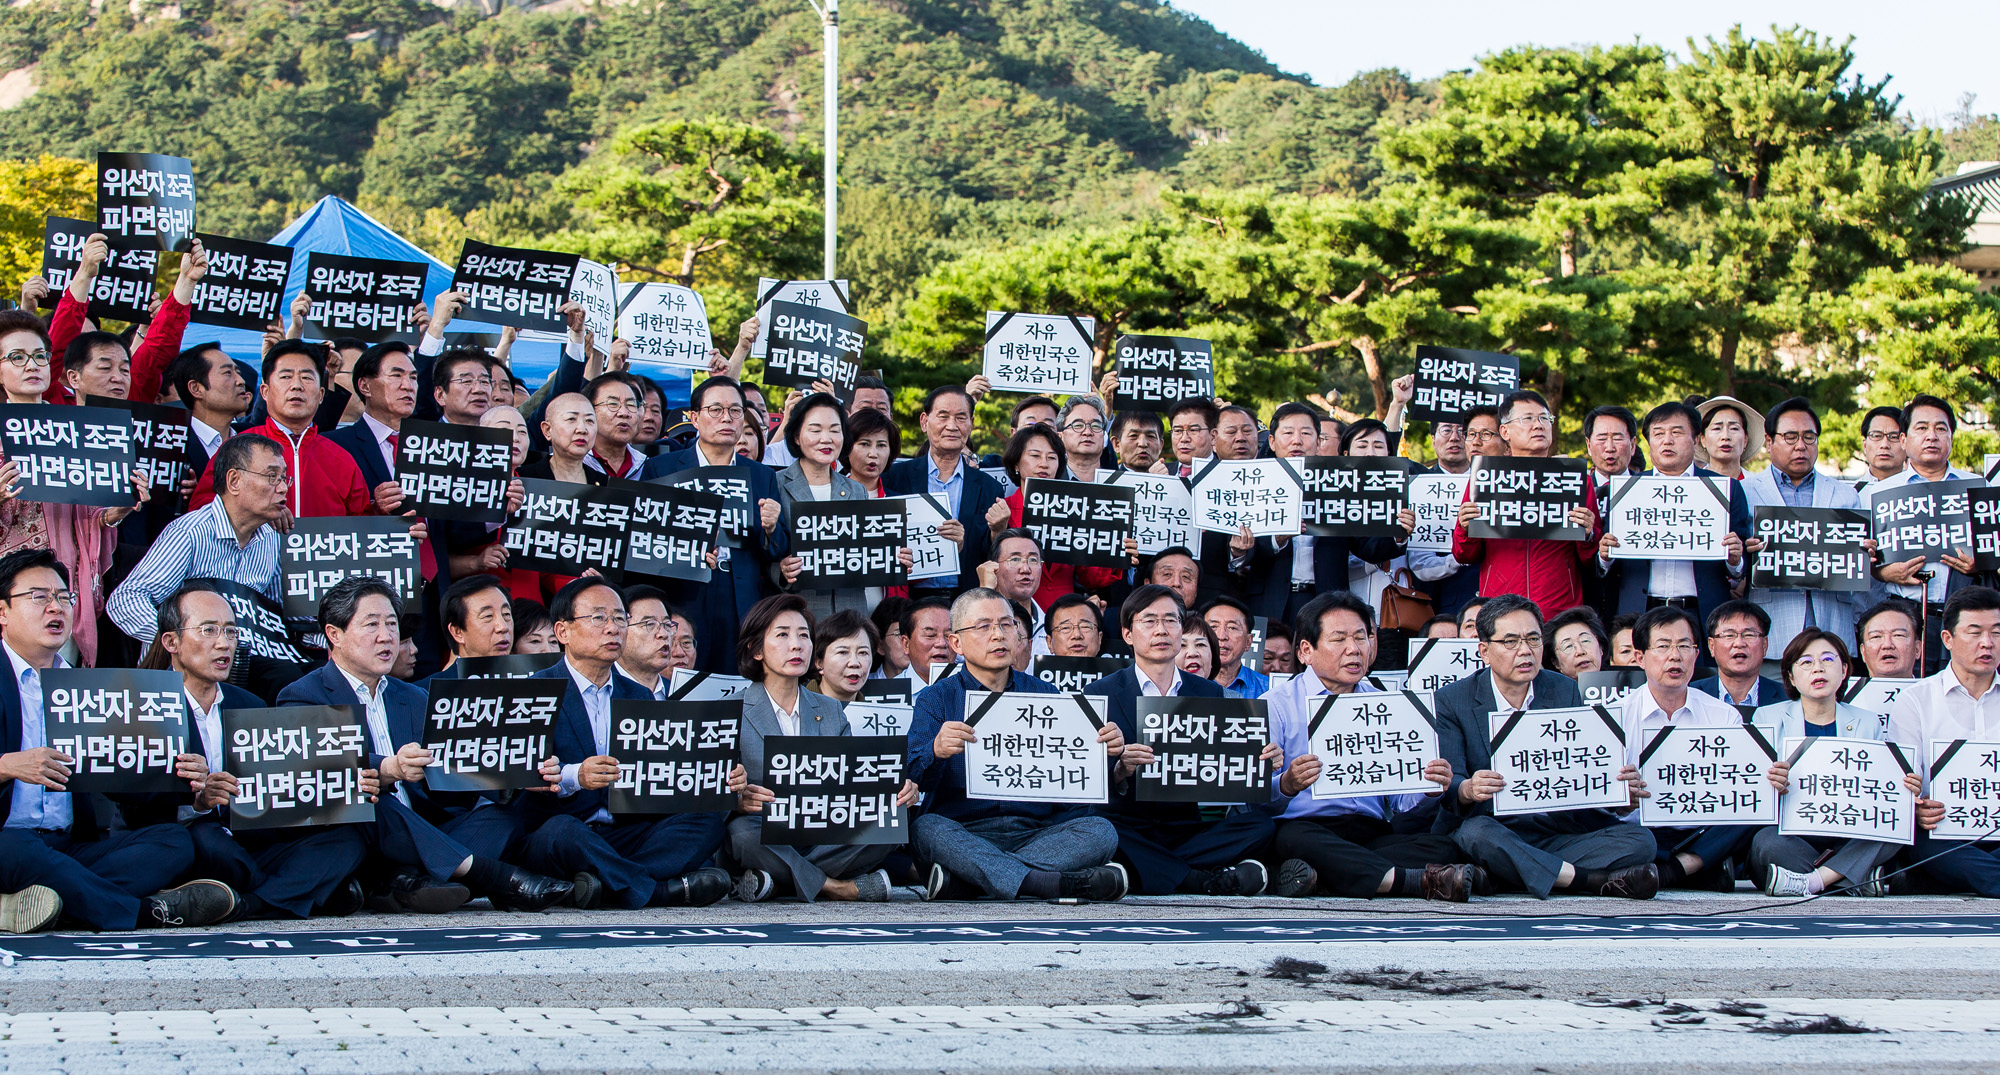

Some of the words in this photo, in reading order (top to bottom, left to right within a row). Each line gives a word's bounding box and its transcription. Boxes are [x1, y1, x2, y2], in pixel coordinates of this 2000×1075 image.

[103, 168, 165, 197] 위선자
[166, 173, 192, 200] 조국
[102, 205, 194, 239] 파면하라!
[118, 250, 157, 274] 조국
[248, 258, 287, 286] 조국
[463, 254, 525, 281] 위선자
[526, 262, 571, 288] 조국
[48, 268, 151, 311] 파하라!
[311, 266, 375, 296] 위선자
[376, 276, 421, 300] 조국
[580, 269, 604, 292] 자유
[456, 281, 562, 321] 파면하라!
[658, 292, 687, 312] 자유
[794, 289, 822, 307] 자유
[306, 301, 415, 333] 파면하라!
[633, 312, 706, 338] 대한민국은
[1024, 322, 1057, 341] 자유
[632, 335, 708, 360] 죽었습니다
[774, 314, 833, 347] 위선자
[835, 328, 864, 358] 조국
[1000, 342, 1080, 364] 대한민국은
[1119, 346, 1176, 371] 위선자
[1179, 350, 1210, 373] 조국
[770, 348, 858, 391] 파면하라!
[996, 364, 1079, 386] 죽었습니다
[1418, 357, 1477, 384] 위선자
[1478, 364, 1517, 390] 조국
[5, 418, 79, 449] 위선자
[84, 423, 130, 453] 조국
[154, 423, 188, 454] 조국
[403, 435, 470, 468] 위선자
[471, 443, 511, 472] 조국
[11, 454, 131, 493] 파면하라!
[1231, 467, 1265, 486] 자유
[1303, 469, 1360, 493] 위선자
[1363, 470, 1405, 492] 조국
[1475, 469, 1537, 494] 위선자
[1540, 471, 1583, 496] 조국
[400, 472, 507, 509] 파면하라!
[708, 478, 749, 502] 조국
[1135, 481, 1168, 501] 자유
[1206, 487, 1289, 506] 대한민국은
[1427, 482, 1460, 500] 자유
[1652, 485, 1688, 503] 자유
[514, 492, 580, 525] 위선자
[582, 501, 630, 532] 조국
[633, 497, 671, 527] 선자
[672, 505, 717, 534] 조국
[1028, 491, 1089, 521] 위선자
[1091, 499, 1132, 524] 조국
[1206, 508, 1288, 528] 죽었습니다
[1626, 507, 1715, 527] 대한민국은
[1875, 494, 1937, 524] 위선자
[796, 514, 860, 541] 위선자
[863, 513, 903, 539] 조국
[1624, 531, 1714, 550] 죽었습니다
[1758, 518, 1820, 545] 위선자
[1824, 522, 1867, 545] 조국
[286, 532, 360, 561] 위선자
[365, 532, 415, 559] 조국
[504, 526, 622, 568] 파면하라!
[630, 531, 708, 569] 면하라!
[796, 546, 901, 577] 파면하라!
[1757, 550, 1863, 579] 파면하라!
[257, 605, 288, 639] 조국
[236, 626, 309, 663] 면하라!
[50, 688, 133, 724] 위선자
[138, 691, 183, 725] 조국
[431, 697, 503, 729] 위선자
[505, 696, 557, 725] 조국
[1014, 704, 1059, 730] 자유
[1352, 703, 1393, 727] 자유
[617, 718, 694, 751] 위선자
[698, 718, 738, 749] 조국
[862, 713, 901, 736] 자유
[1142, 713, 1217, 746] 위선자
[1223, 716, 1268, 747] 조국
[1540, 719, 1581, 743] 자유
[233, 726, 310, 763] 위선자
[316, 724, 365, 757] 조국
[426, 734, 546, 774] 파면하라!
[982, 733, 1090, 761] 대한민국은
[1325, 729, 1424, 757] 대한민국은
[1688, 735, 1730, 759] 자유
[769, 753, 848, 786] 위선자
[852, 754, 902, 784] 조국
[1142, 752, 1265, 788] 파면하라!
[1326, 757, 1426, 786] 죽었습니다
[1510, 744, 1611, 773] 대한민국은
[1830, 748, 1873, 772] 자유
[1979, 750, 2000, 773] 자
[235, 768, 366, 810] 파면하라!
[982, 763, 1090, 791] 죽었습니다
[1510, 773, 1611, 801] 죽었습니다
[1657, 763, 1762, 786] 대한민국은
[1799, 774, 1900, 802] 대한민국은
[767, 793, 899, 829] 파면하라!
[1655, 790, 1762, 814] 죽었습니다
[1796, 802, 1899, 831] 죽었습니다
